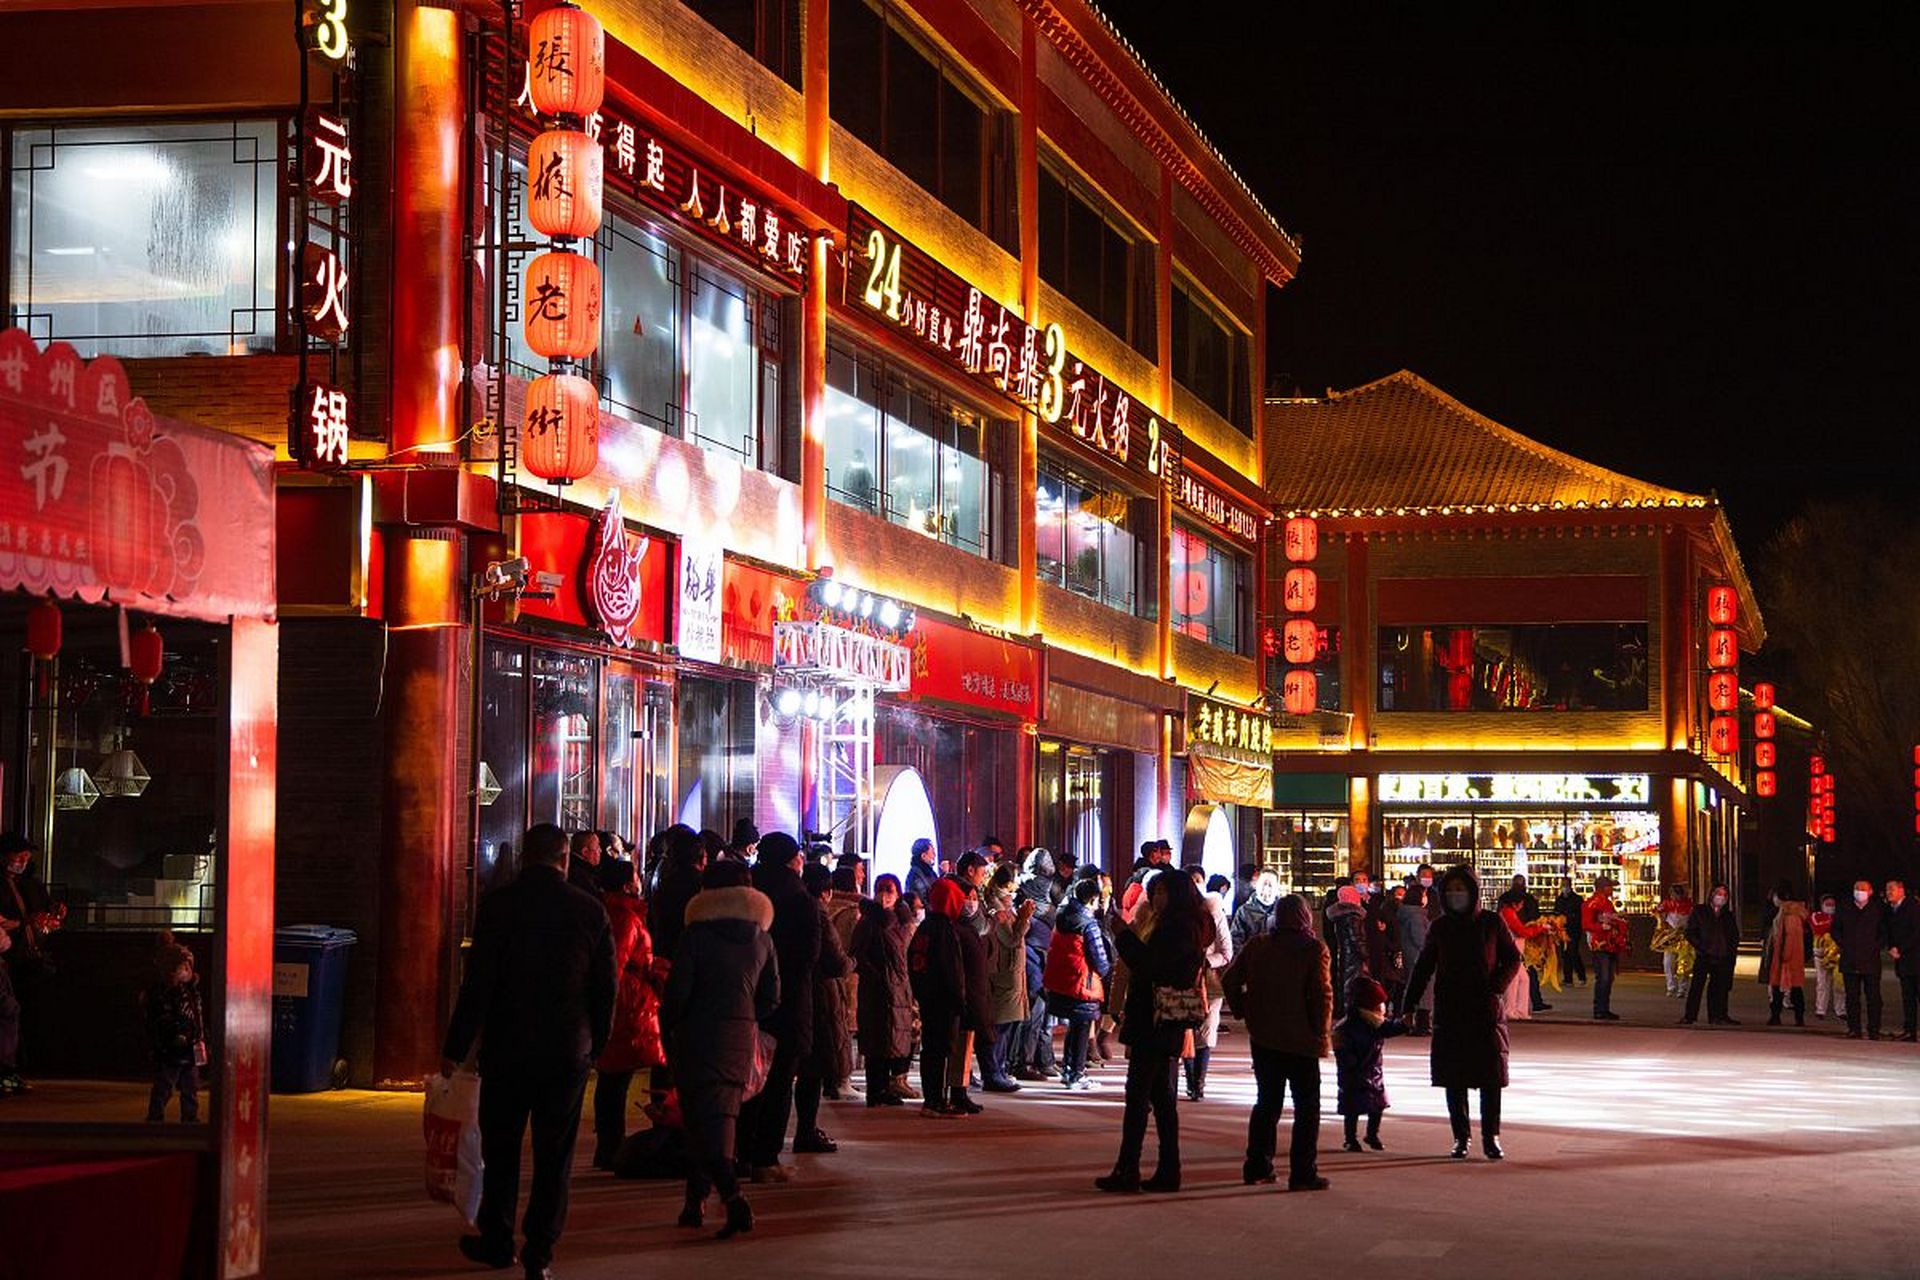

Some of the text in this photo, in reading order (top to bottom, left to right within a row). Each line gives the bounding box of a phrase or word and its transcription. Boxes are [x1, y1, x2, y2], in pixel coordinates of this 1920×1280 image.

[517, 61, 803, 275] 人吃得起 人人都爱吃
[0, 350, 119, 417] 甘州区
[21, 422, 69, 512] 节
